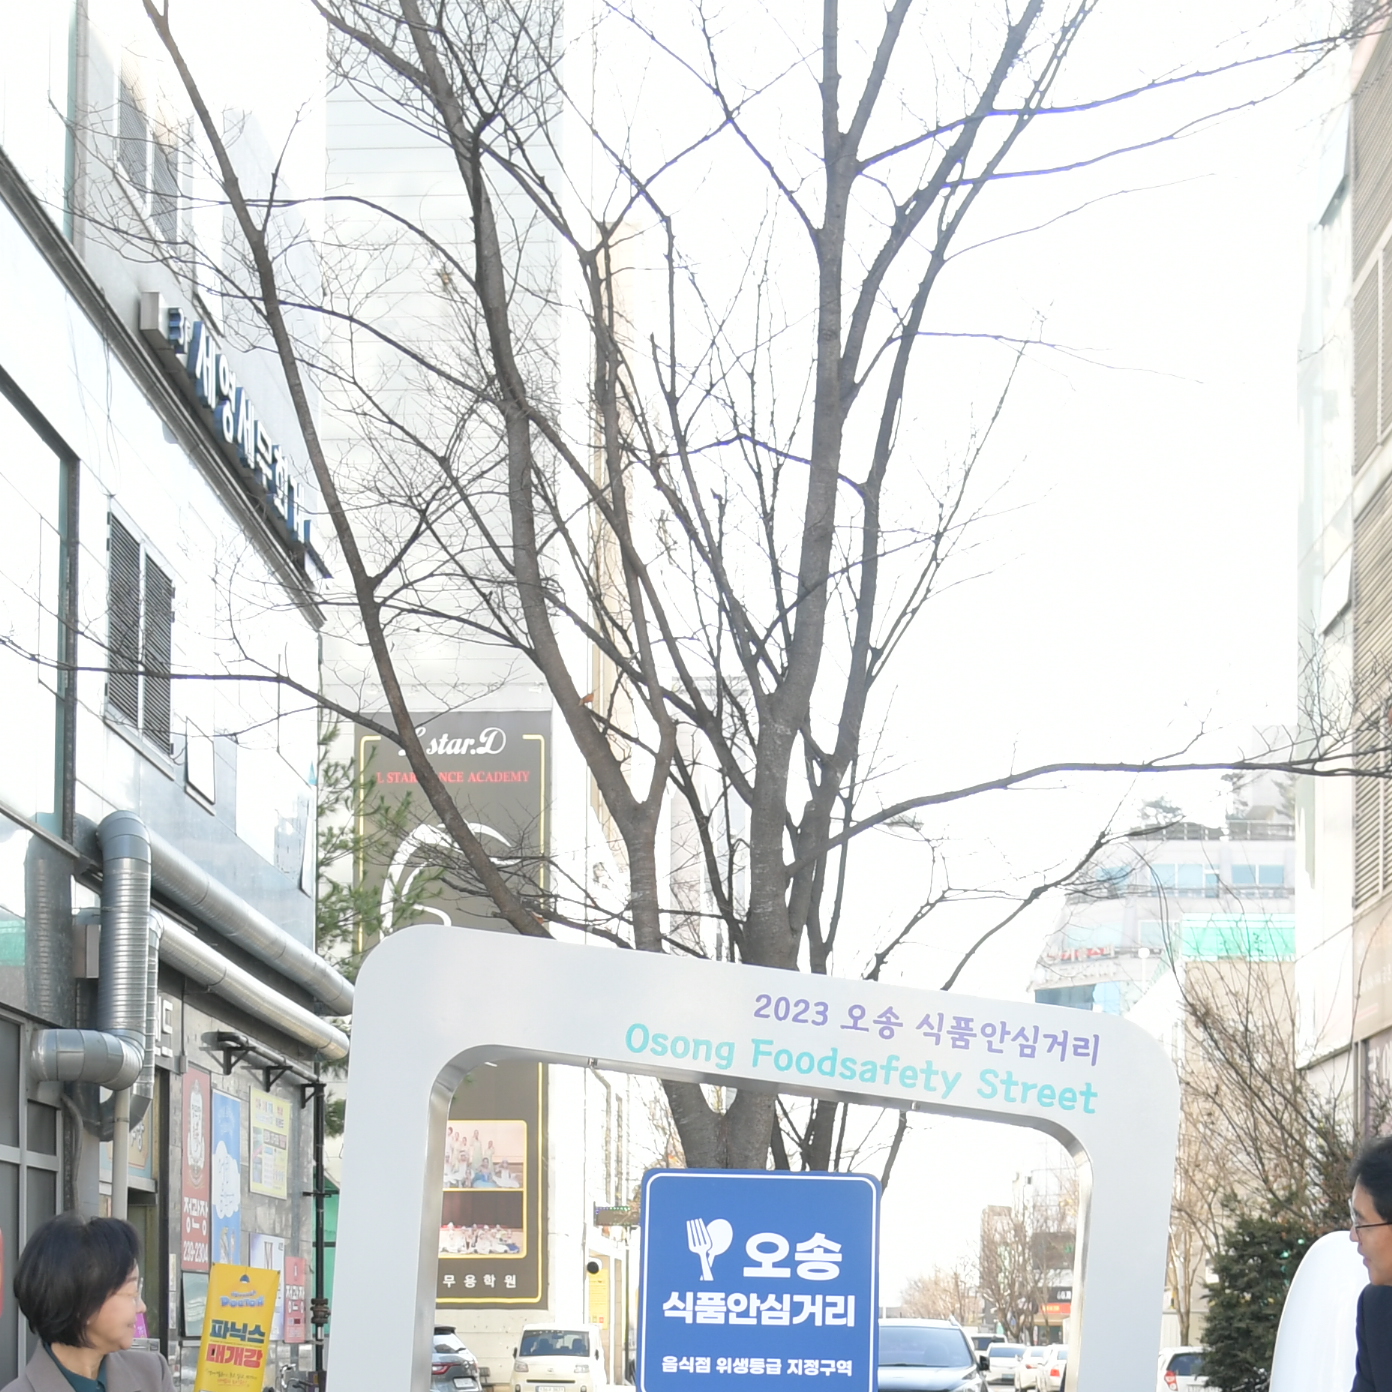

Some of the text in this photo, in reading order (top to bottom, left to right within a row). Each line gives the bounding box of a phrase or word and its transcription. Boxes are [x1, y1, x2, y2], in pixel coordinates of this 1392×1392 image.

[467, 770, 531, 784] ACADEMY
[753, 993, 1101, 1067] 2023 오송 식품안심거리
[625, 1022, 1099, 1115] Osong Foodsafety Street
[183, 1197, 208, 1235] 정관장
[743, 1232, 843, 1281] 오송
[662, 1291, 856, 1327] 식품안심거리
[210, 1319, 265, 1344] 파닉스
[206, 1343, 263, 1368] 대개강
[661, 1356, 852, 1377] 음식점 위생등급 지정구역
